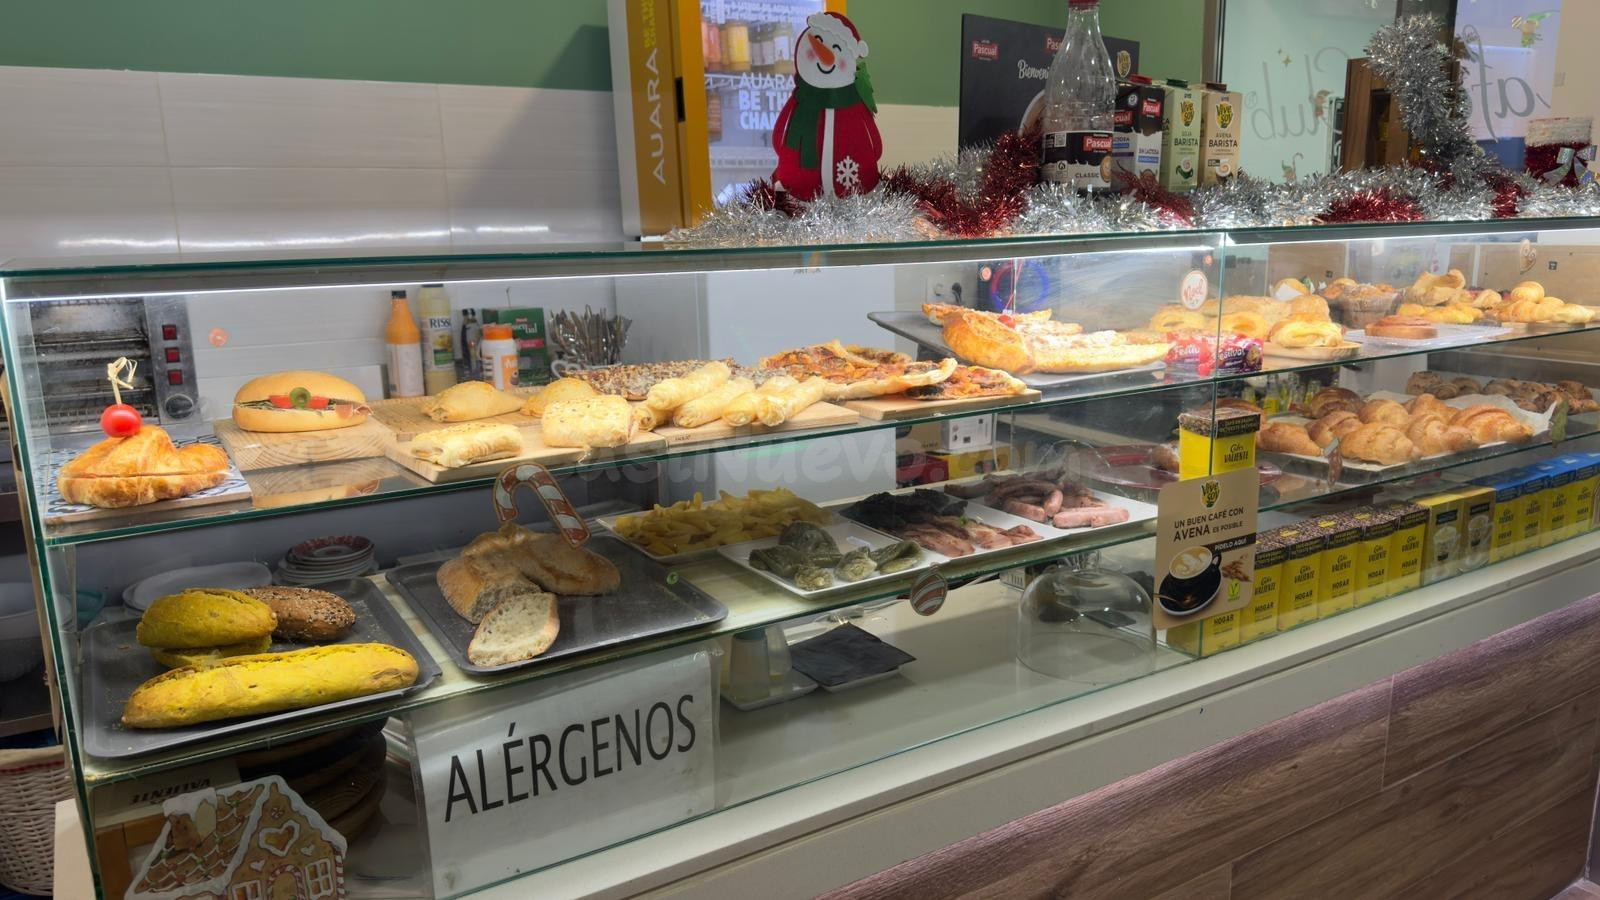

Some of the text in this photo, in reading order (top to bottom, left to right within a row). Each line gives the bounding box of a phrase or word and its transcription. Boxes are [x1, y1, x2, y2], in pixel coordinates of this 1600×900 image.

[740, 72, 796, 89] AUARA
[739, 89, 790, 111] BE TH
[645, 48, 666, 185] AUARA
[1086, 138, 1112, 148] Pascual
[1174, 138, 1198, 146] BARISTA
[1208, 139, 1238, 148] BARISTA
[1174, 520, 1185, 529] UN
[1187, 516, 1206, 526] BUEN
[1229, 507, 1244, 517] CON
[1173, 524, 1210, 542] AVENA
[1295, 590, 1313, 601] HOGAR
[1255, 602, 1274, 613] HOGAR
[1214, 614, 1234, 625] HOGAR
[445, 695, 696, 823] ALÉRGENOS
